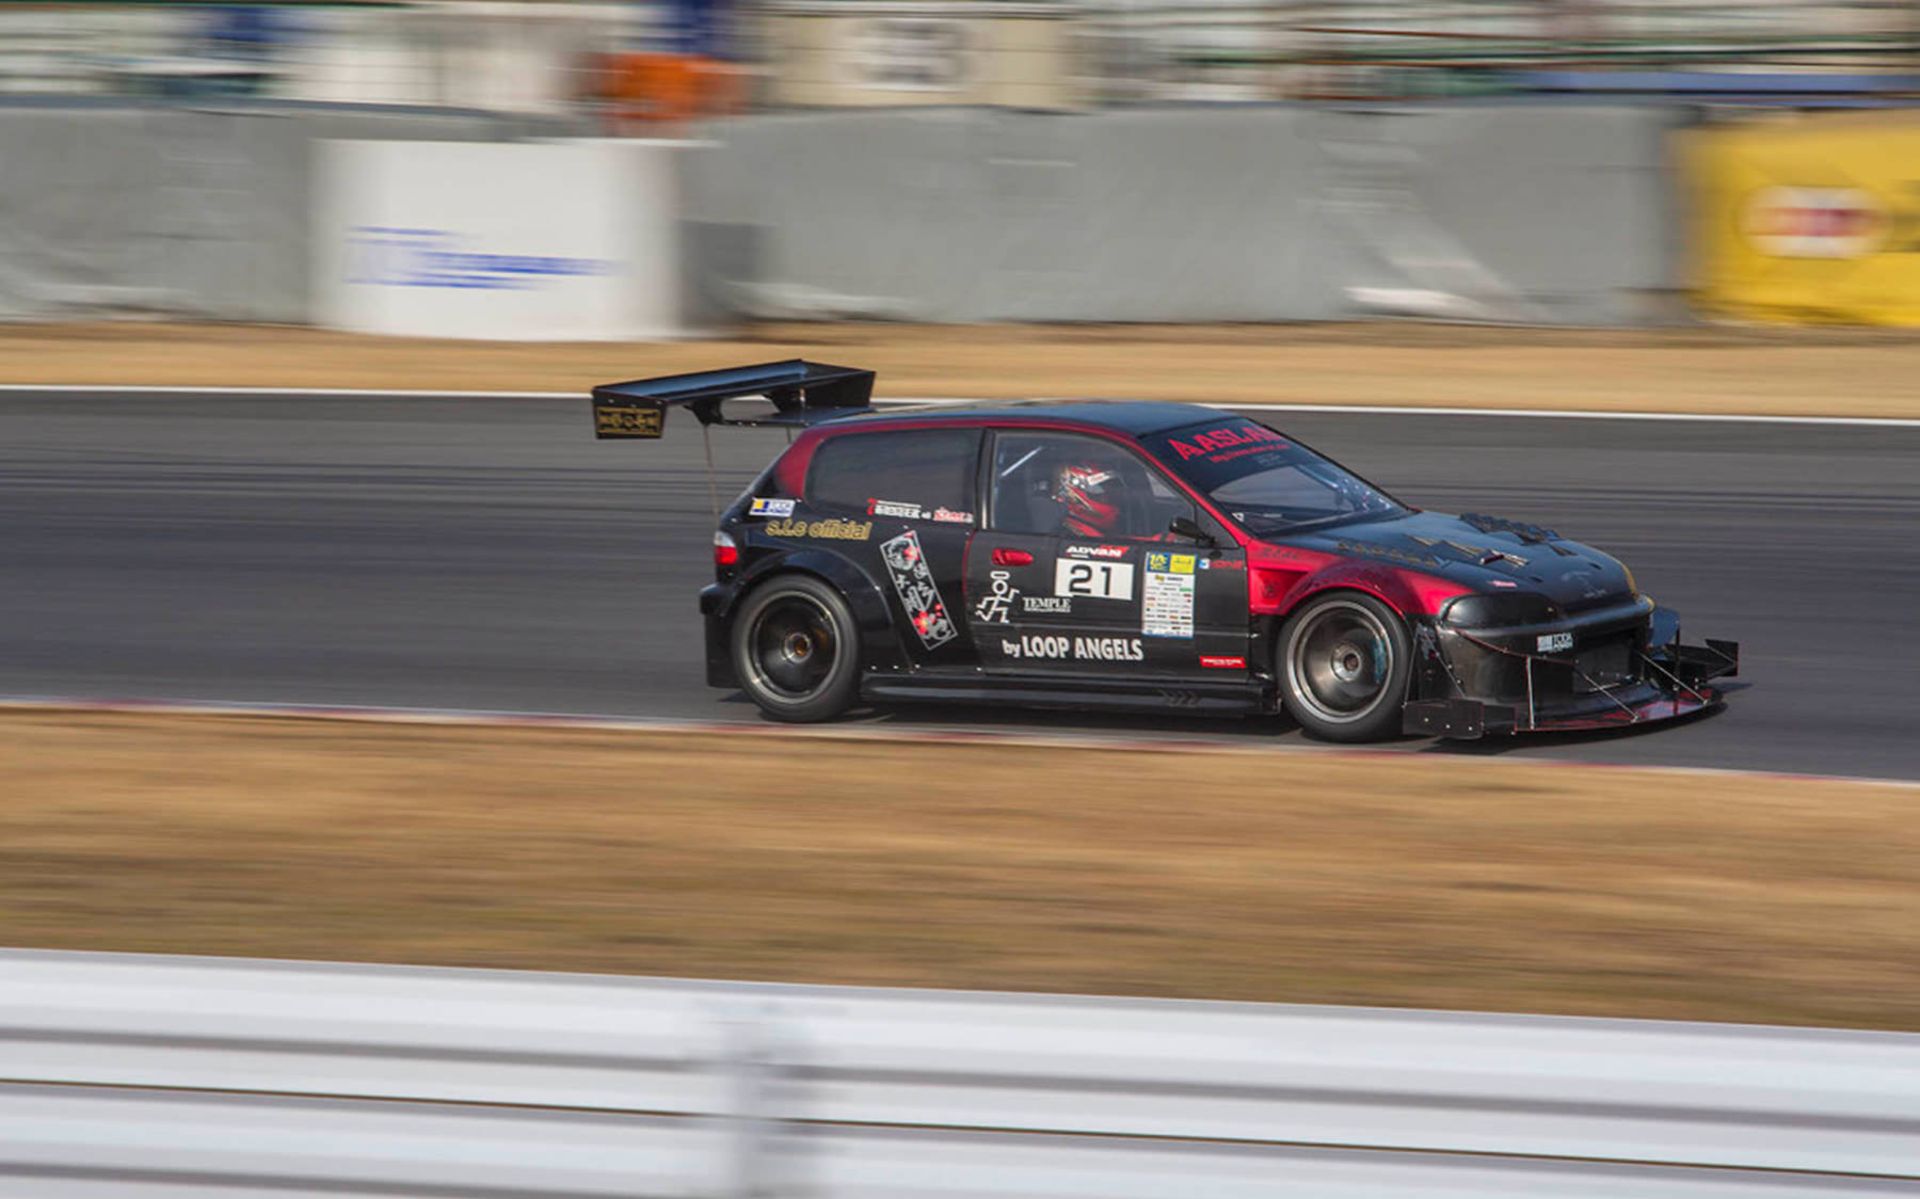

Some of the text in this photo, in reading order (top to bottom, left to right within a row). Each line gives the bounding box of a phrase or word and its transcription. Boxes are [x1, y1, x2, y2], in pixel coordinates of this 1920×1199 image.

[1066, 545, 1122, 558] ADVAN
[1069, 564, 1112, 596] 21
[1022, 597, 1071, 609] TEMPLE
[1002, 635, 1145, 661] by LOOP ANGELS
